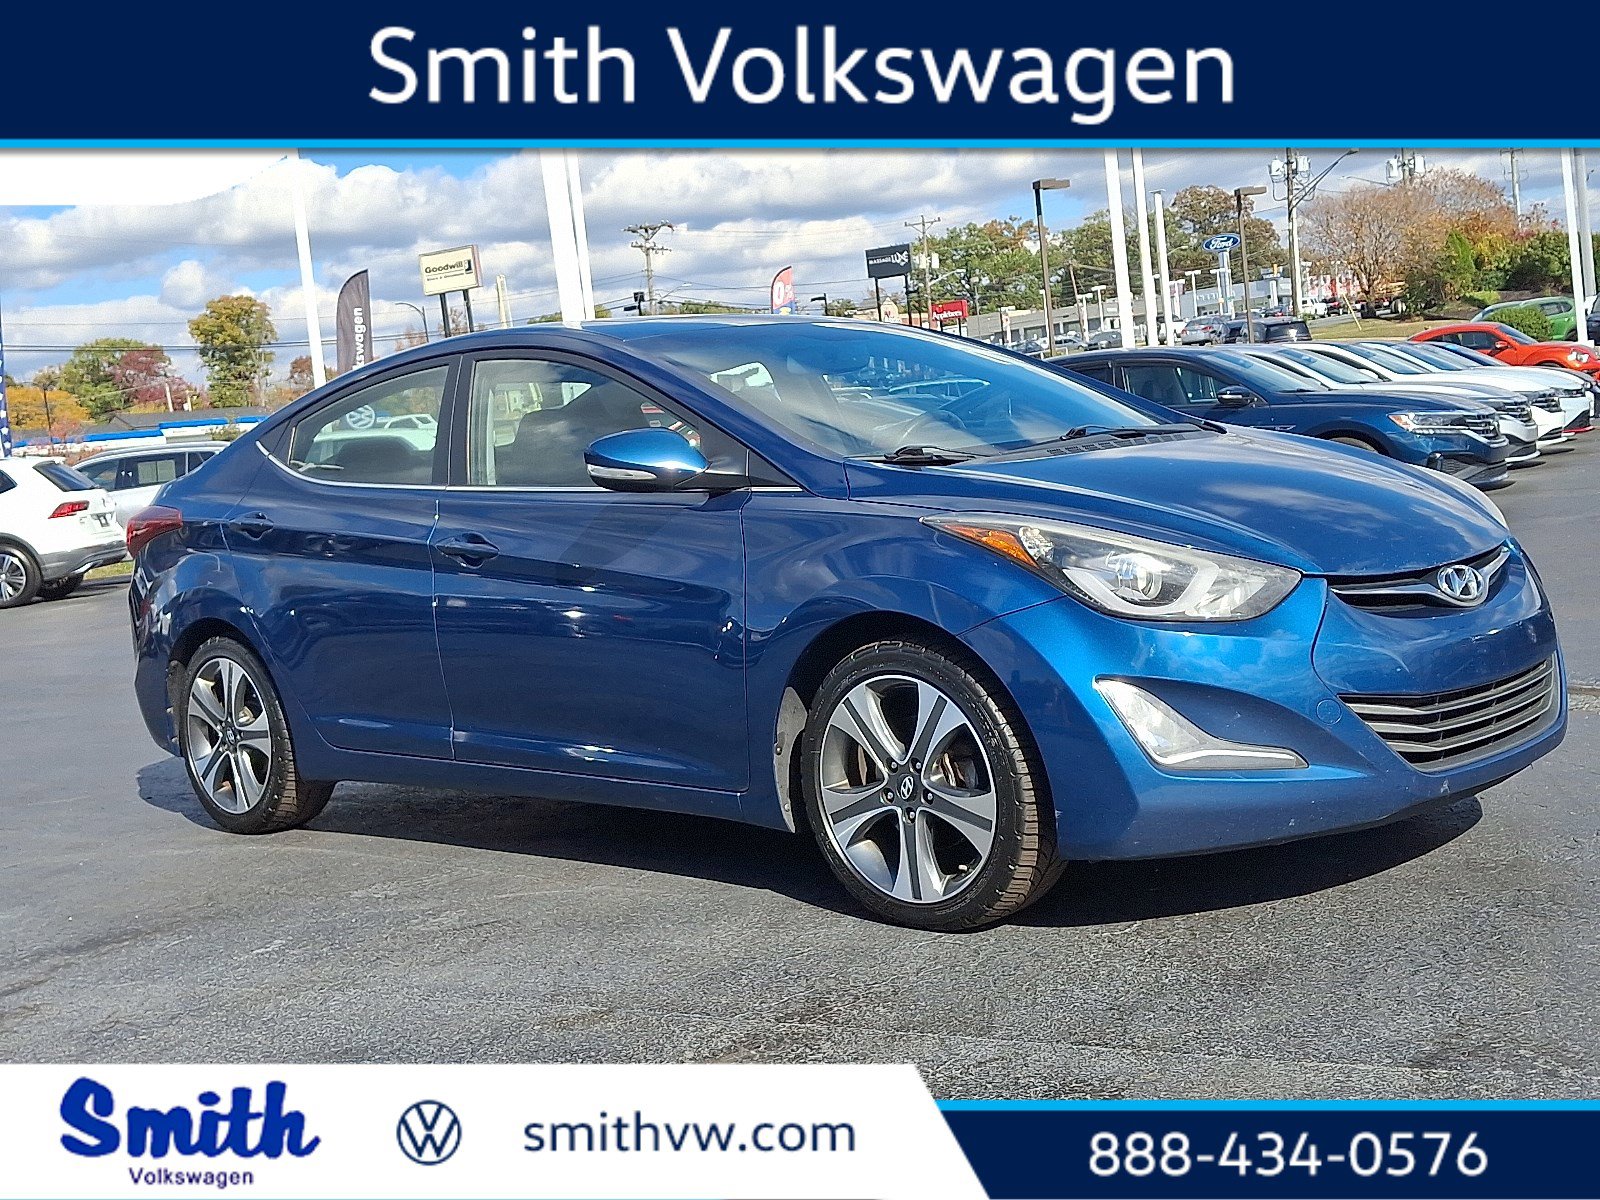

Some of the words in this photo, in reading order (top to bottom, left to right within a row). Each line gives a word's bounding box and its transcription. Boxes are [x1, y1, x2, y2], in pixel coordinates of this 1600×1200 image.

[1209, 235, 1234, 249] Ford
[424, 260, 464, 274] Goodwill
[772, 280, 794, 306] 0%
